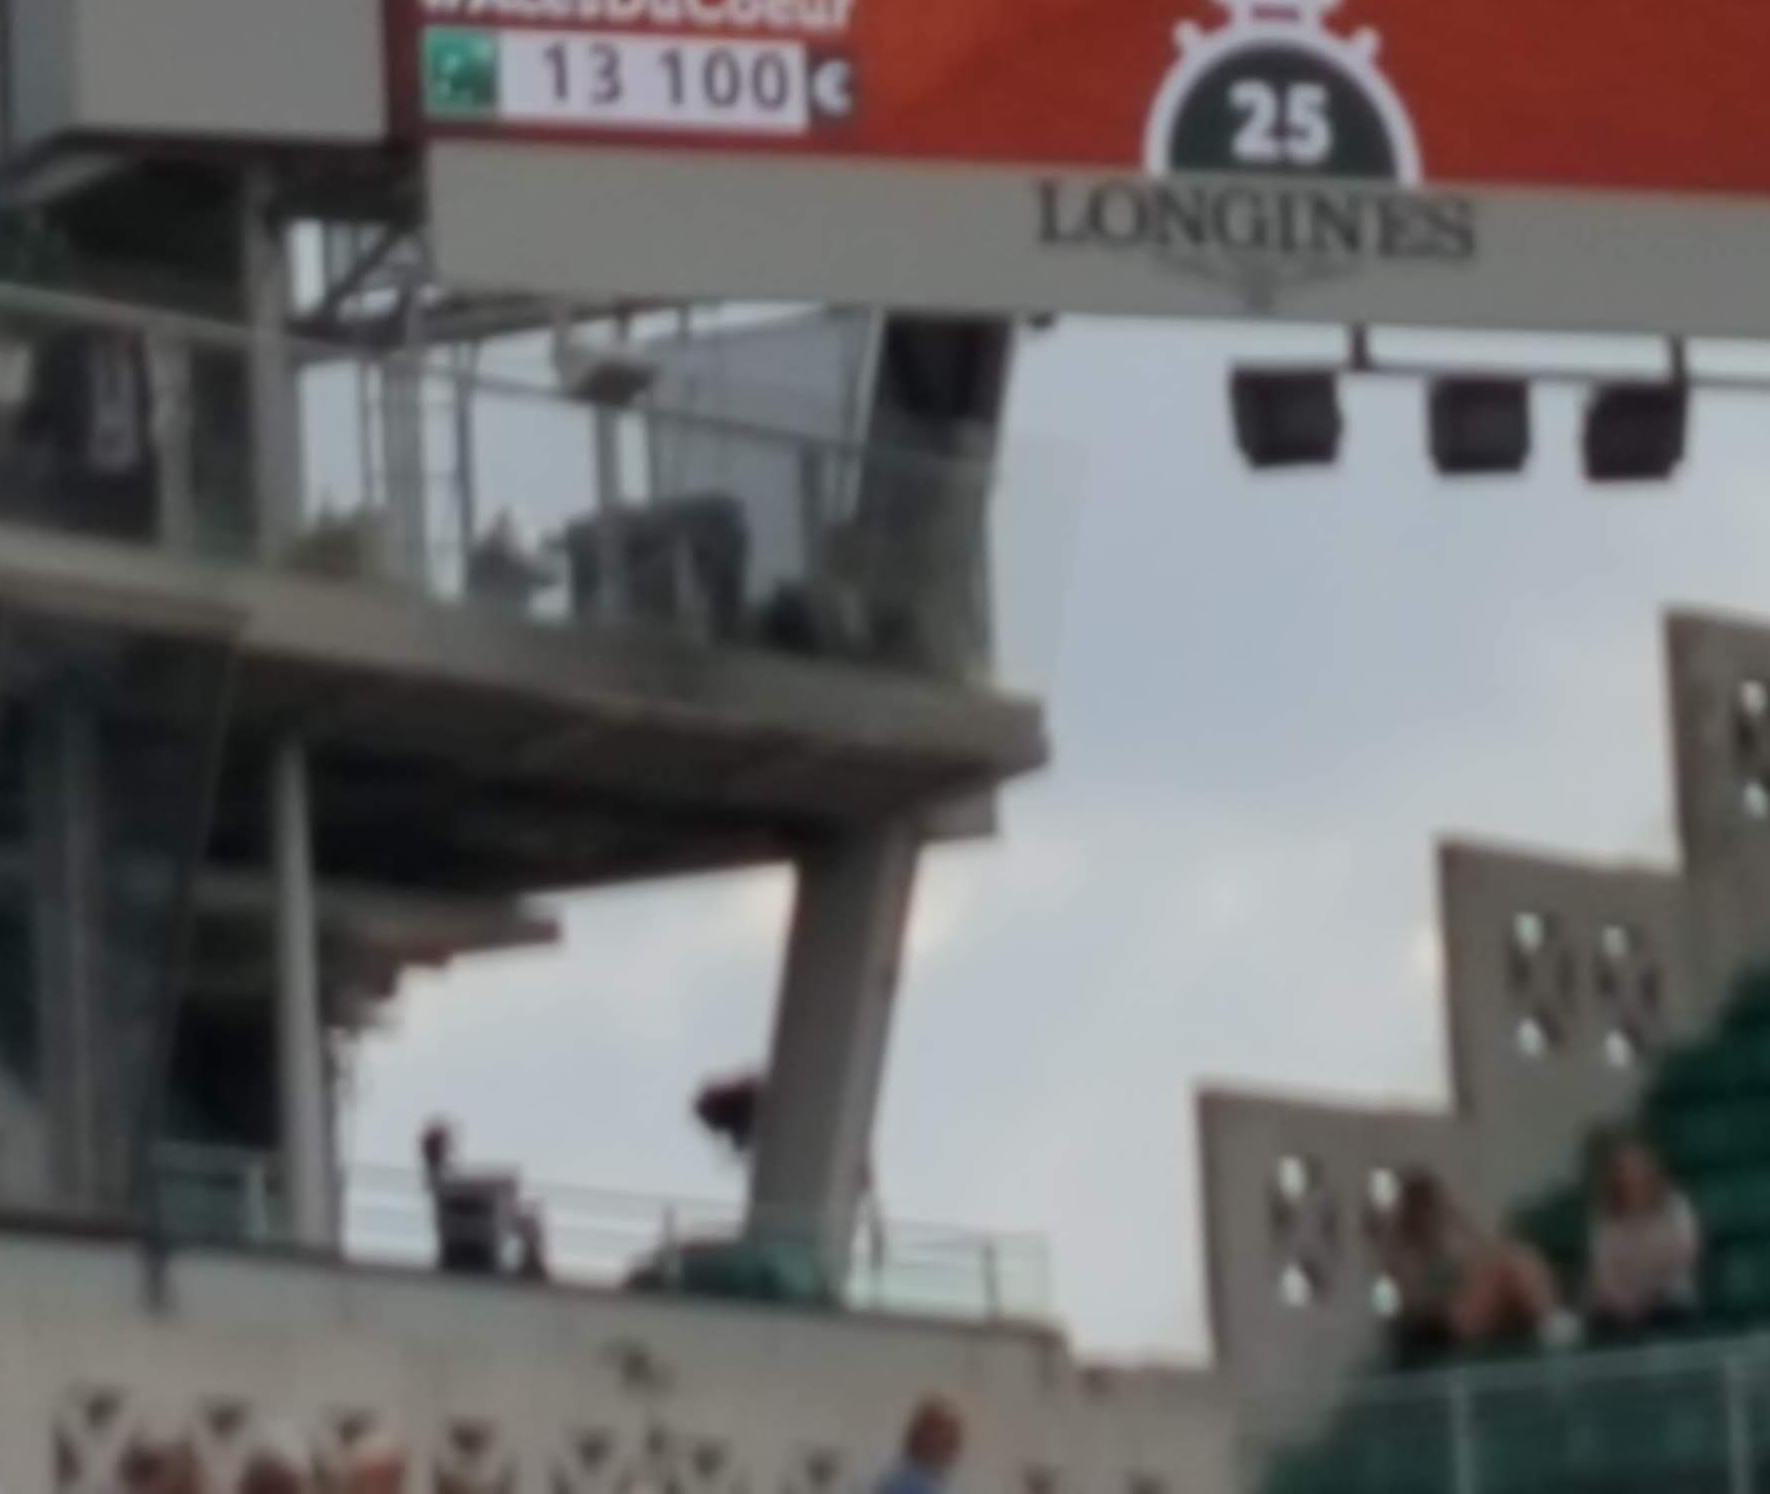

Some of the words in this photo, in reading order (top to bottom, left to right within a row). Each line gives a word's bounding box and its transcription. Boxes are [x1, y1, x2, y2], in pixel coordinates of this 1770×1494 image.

[543, 42, 625, 105] 13
[1229, 80, 1333, 164] 25
[1037, 176, 1477, 260] LONGINES
